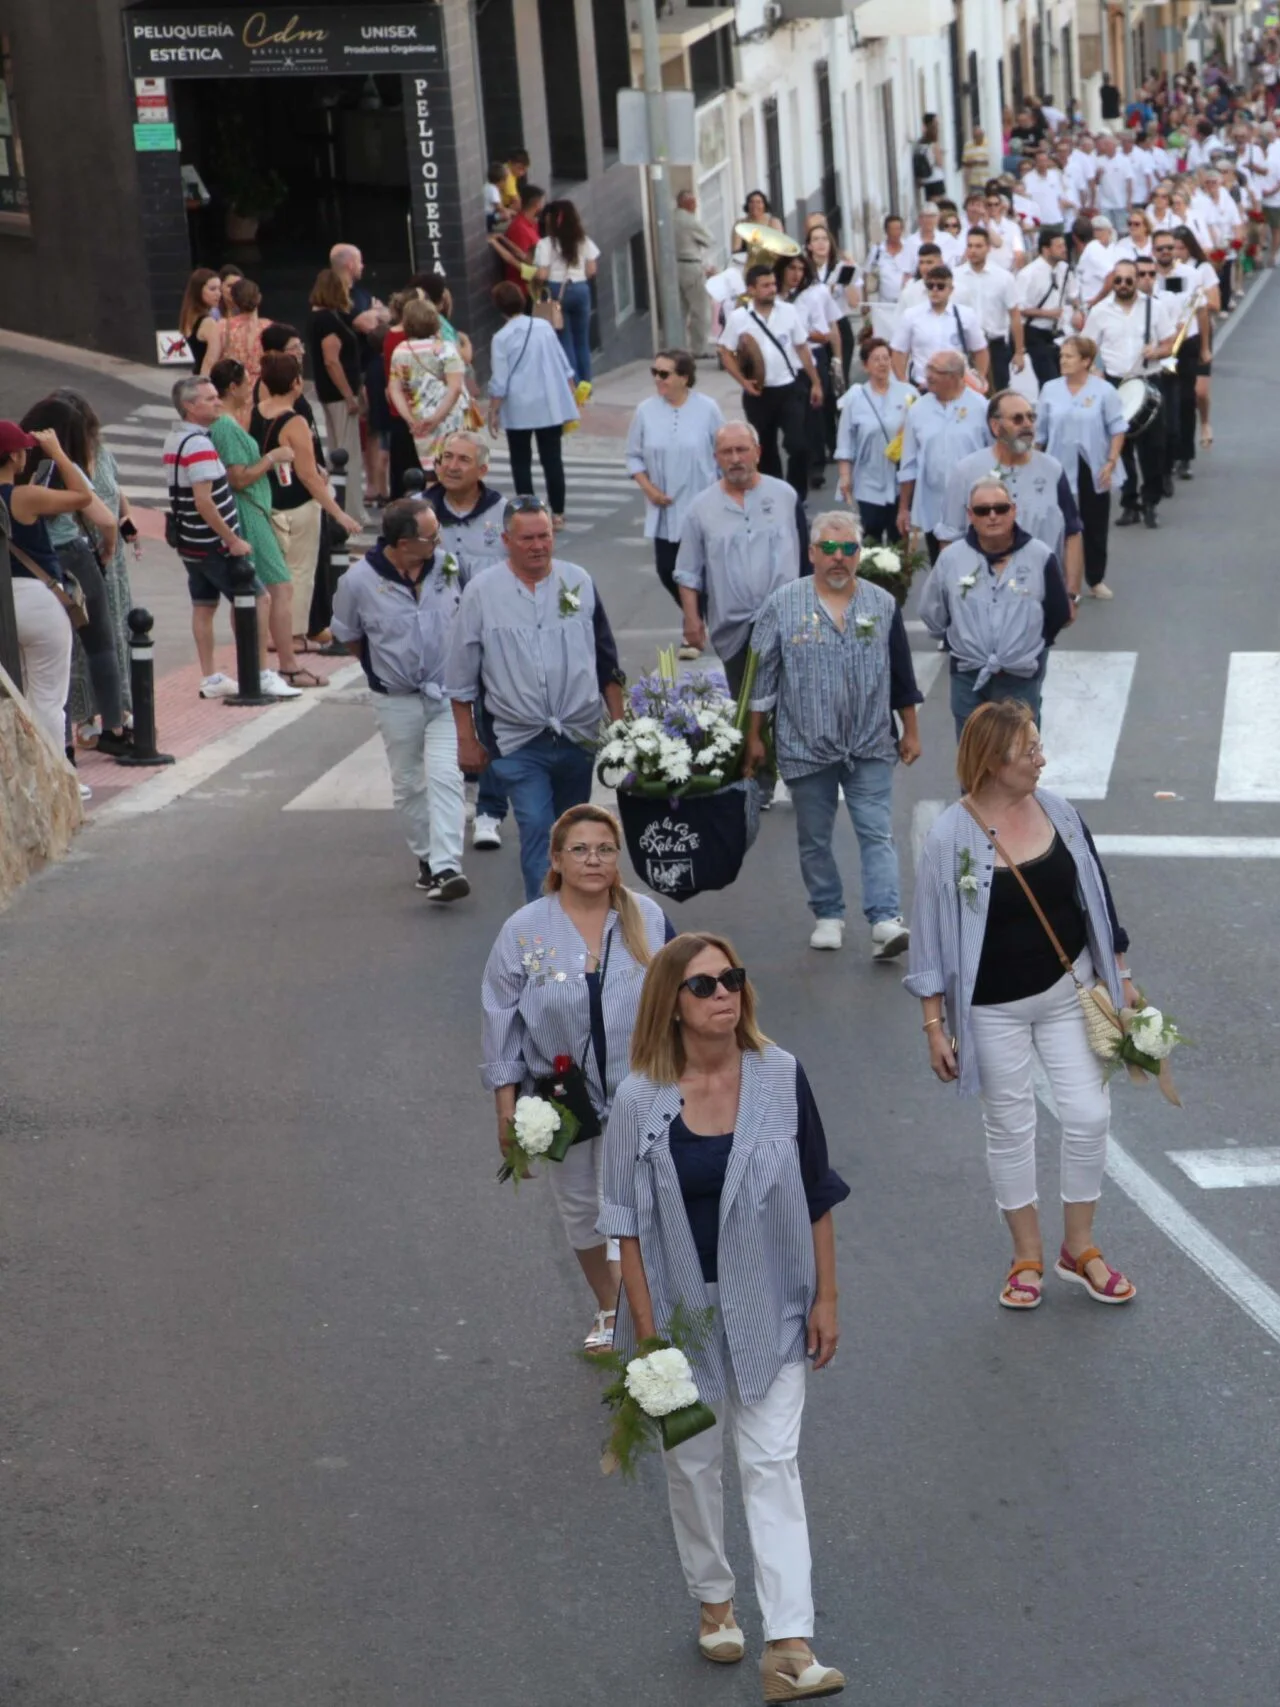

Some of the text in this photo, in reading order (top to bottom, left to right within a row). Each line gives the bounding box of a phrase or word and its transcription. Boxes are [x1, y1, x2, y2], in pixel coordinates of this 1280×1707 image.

[133, 22, 235, 40] PELUQUERÍA
[360, 25, 417, 39] UNISEX
[150, 46, 223, 62] ESTÉTICA
[343, 45, 390, 54] Productos
[414, 78, 447, 277] PELUQUERIA
